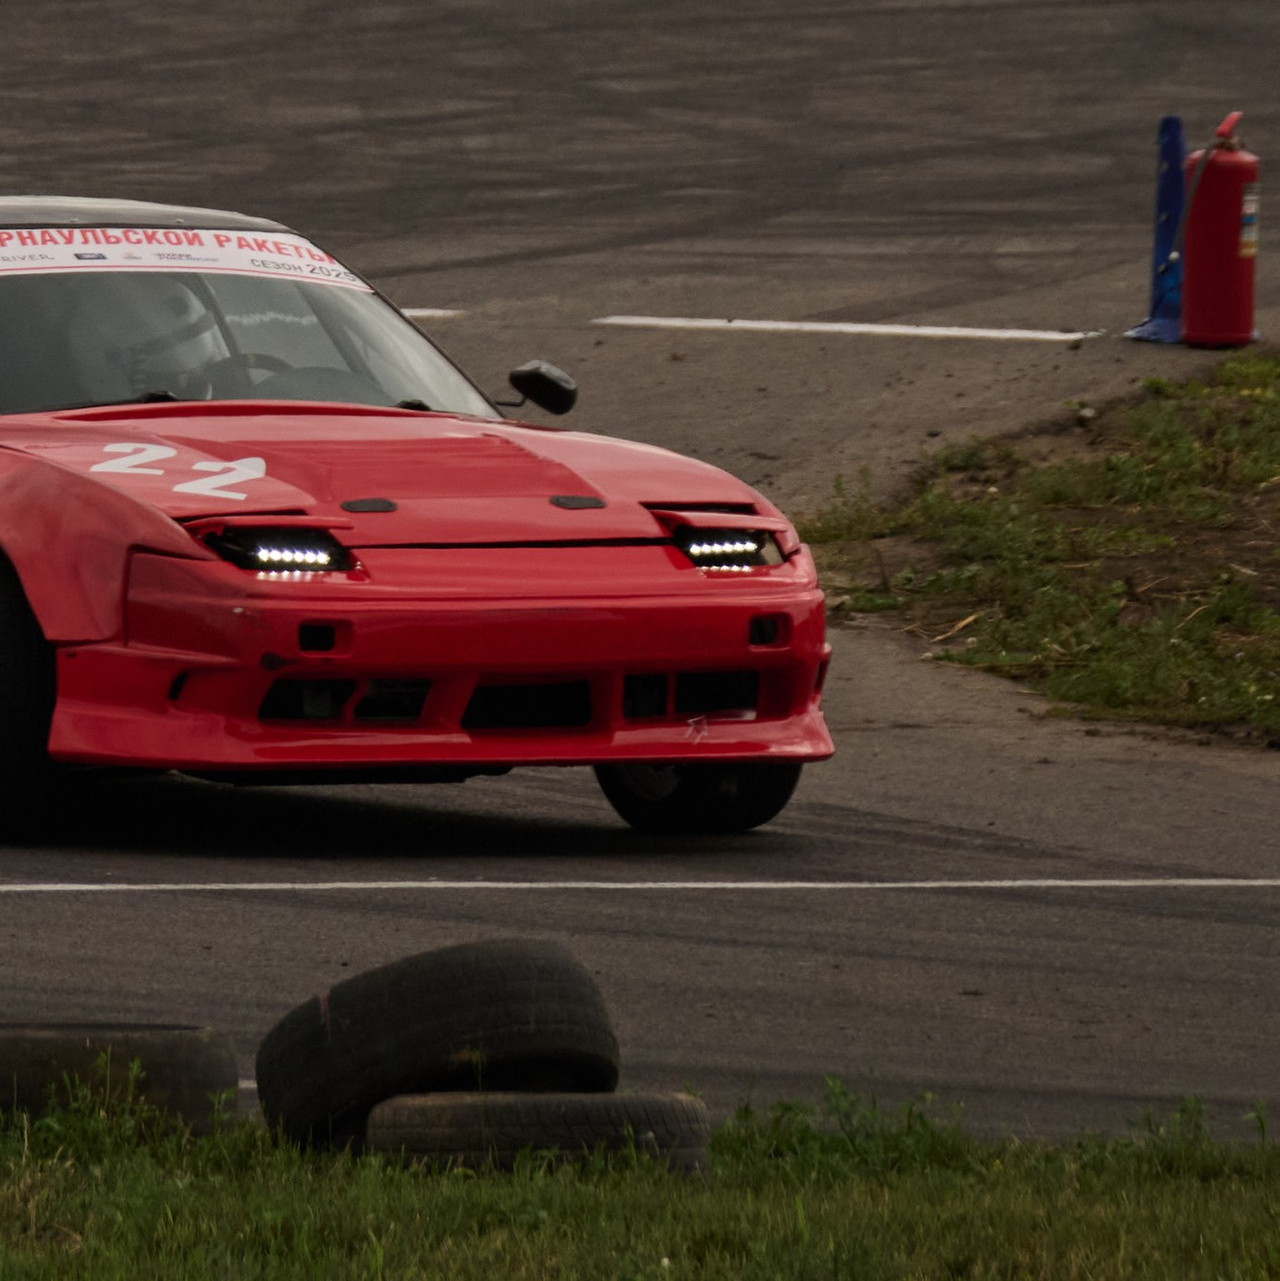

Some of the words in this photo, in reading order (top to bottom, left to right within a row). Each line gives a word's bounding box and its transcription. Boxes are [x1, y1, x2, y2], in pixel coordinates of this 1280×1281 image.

[216, 233, 337, 265] РАКЕТЫ
[250, 258, 303, 273] СЕЗОН
[305, 263, 357, 283] 2025
[89, 442, 267, 502] 22
